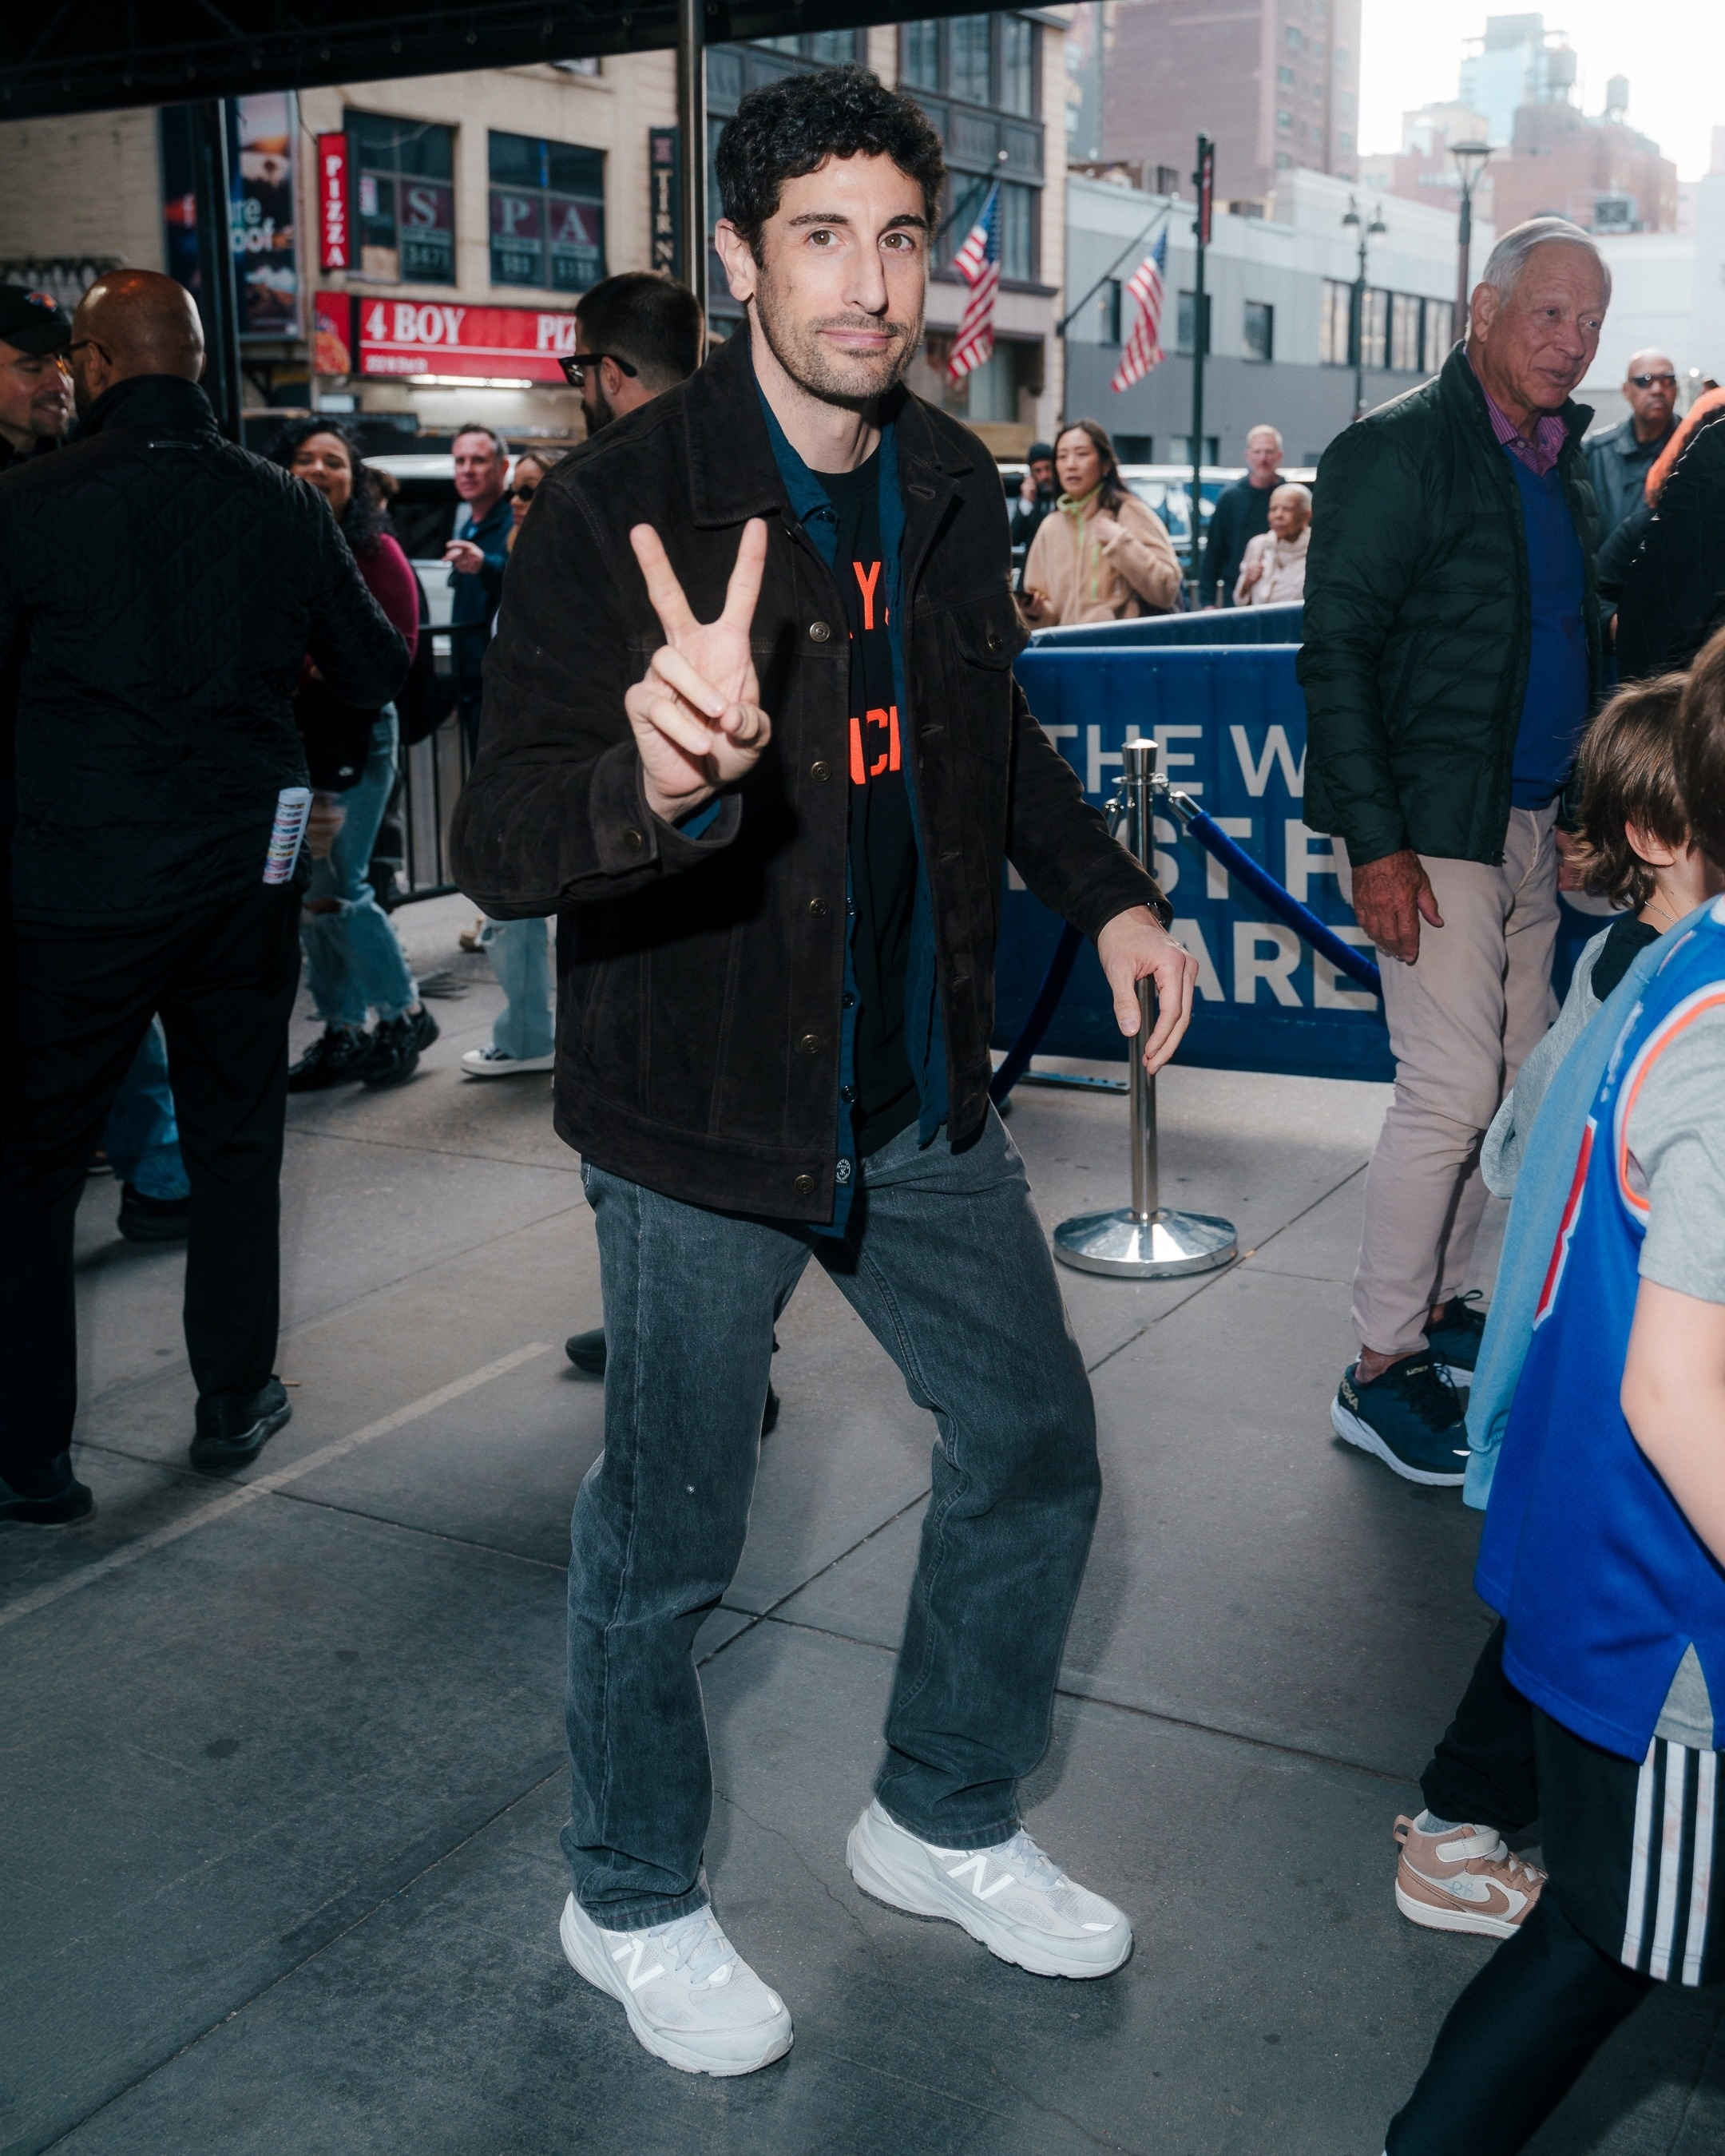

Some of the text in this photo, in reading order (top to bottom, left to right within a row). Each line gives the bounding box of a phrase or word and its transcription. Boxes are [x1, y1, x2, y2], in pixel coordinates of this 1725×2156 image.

[325, 155, 346, 268] PIZZA
[365, 301, 387, 342] 4
[394, 303, 466, 345] BOY
[536, 314, 577, 351] PIZ
[1230, 724, 1308, 799] W
[1155, 918, 1380, 1013] ARE
